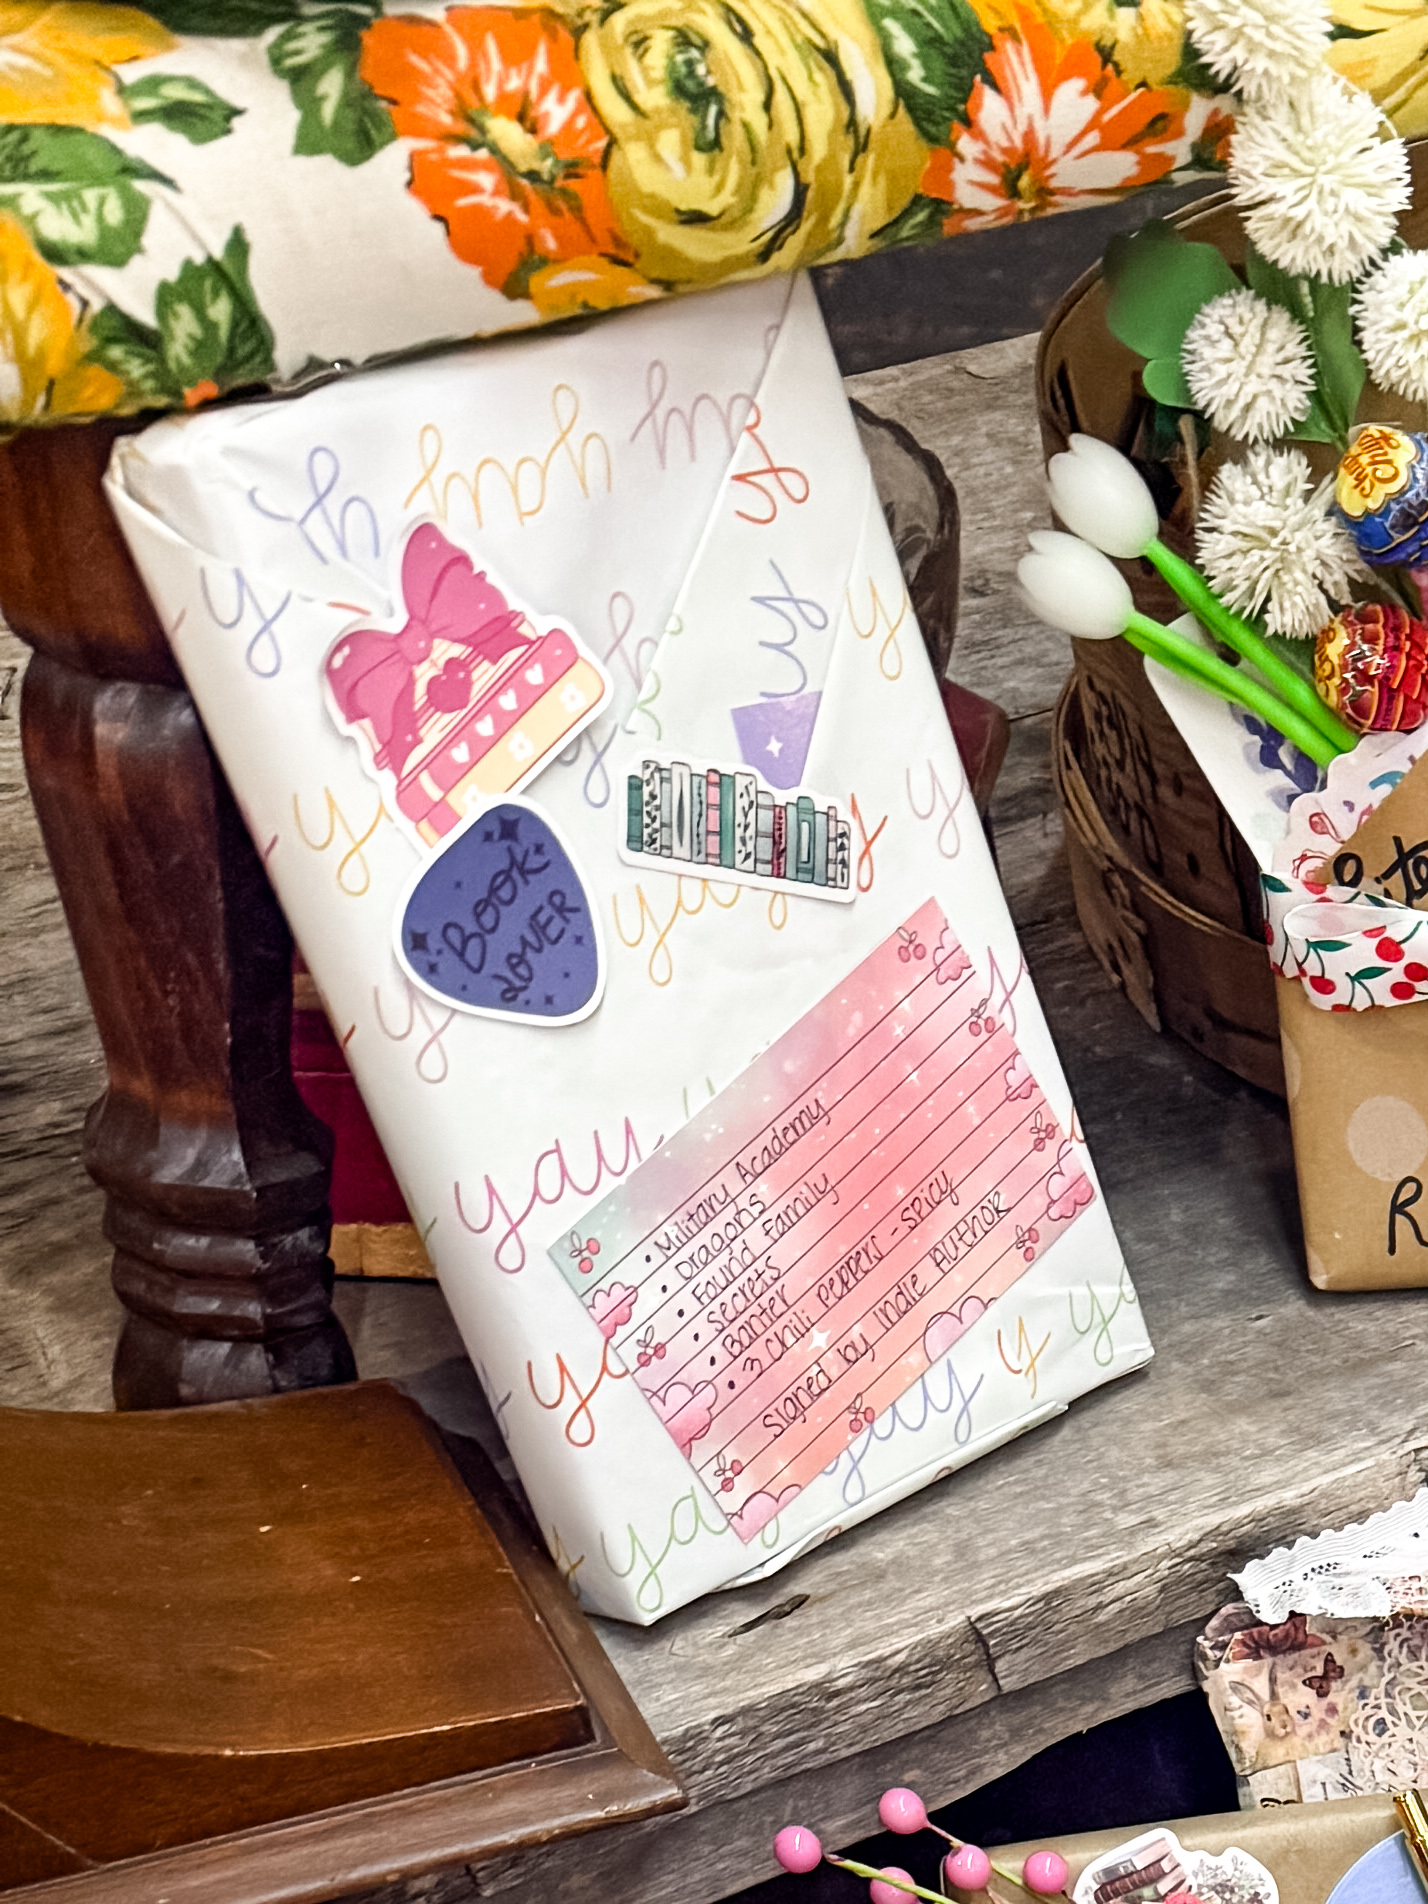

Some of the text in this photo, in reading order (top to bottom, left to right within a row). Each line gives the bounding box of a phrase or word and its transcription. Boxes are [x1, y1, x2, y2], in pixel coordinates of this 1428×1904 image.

[445, 846, 551, 974] BOOK
[495, 880, 584, 1004] LOVER
[653, 1098, 833, 1263] Military Academy
[722, 1283, 790, 1357] Banter
[839, 1331, 877, 1369] by
